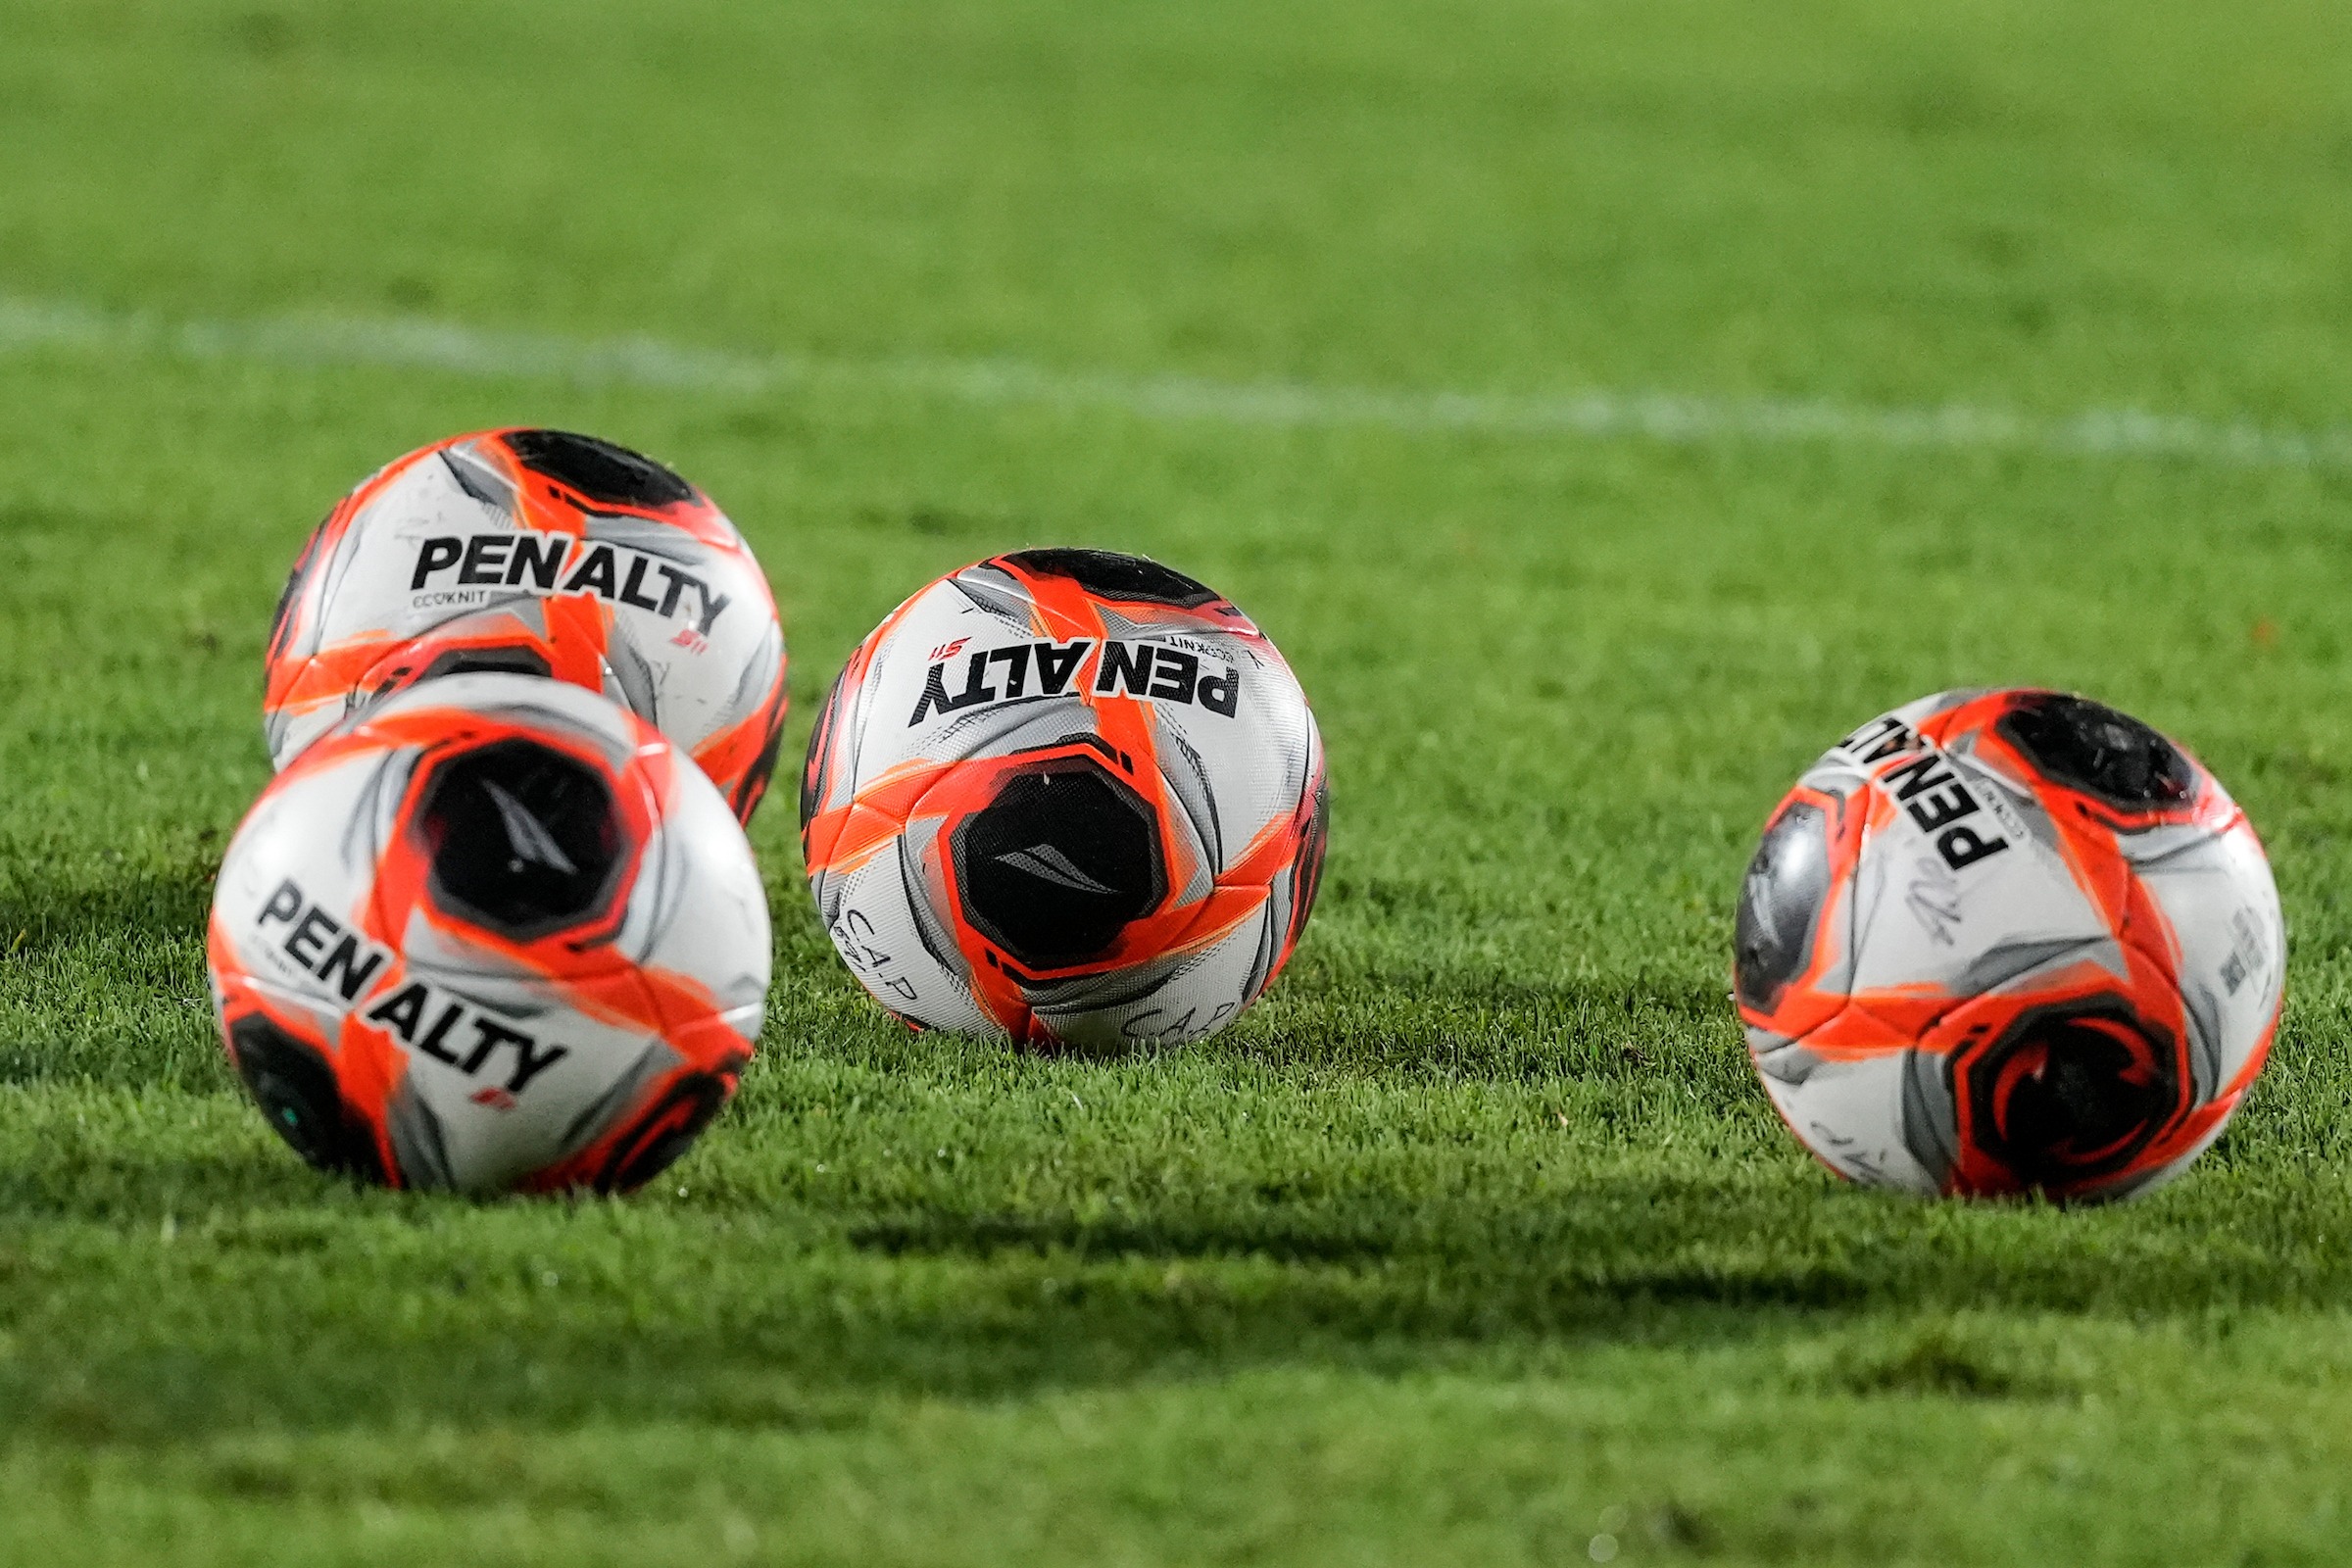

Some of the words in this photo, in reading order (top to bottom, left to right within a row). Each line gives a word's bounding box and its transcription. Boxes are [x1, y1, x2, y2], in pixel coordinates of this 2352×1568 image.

[410, 534, 731, 637] PENALTY
[907, 640, 1241, 728] PENALTY
[927, 636, 972, 662] S11
[257, 879, 568, 1093] PENALTY
